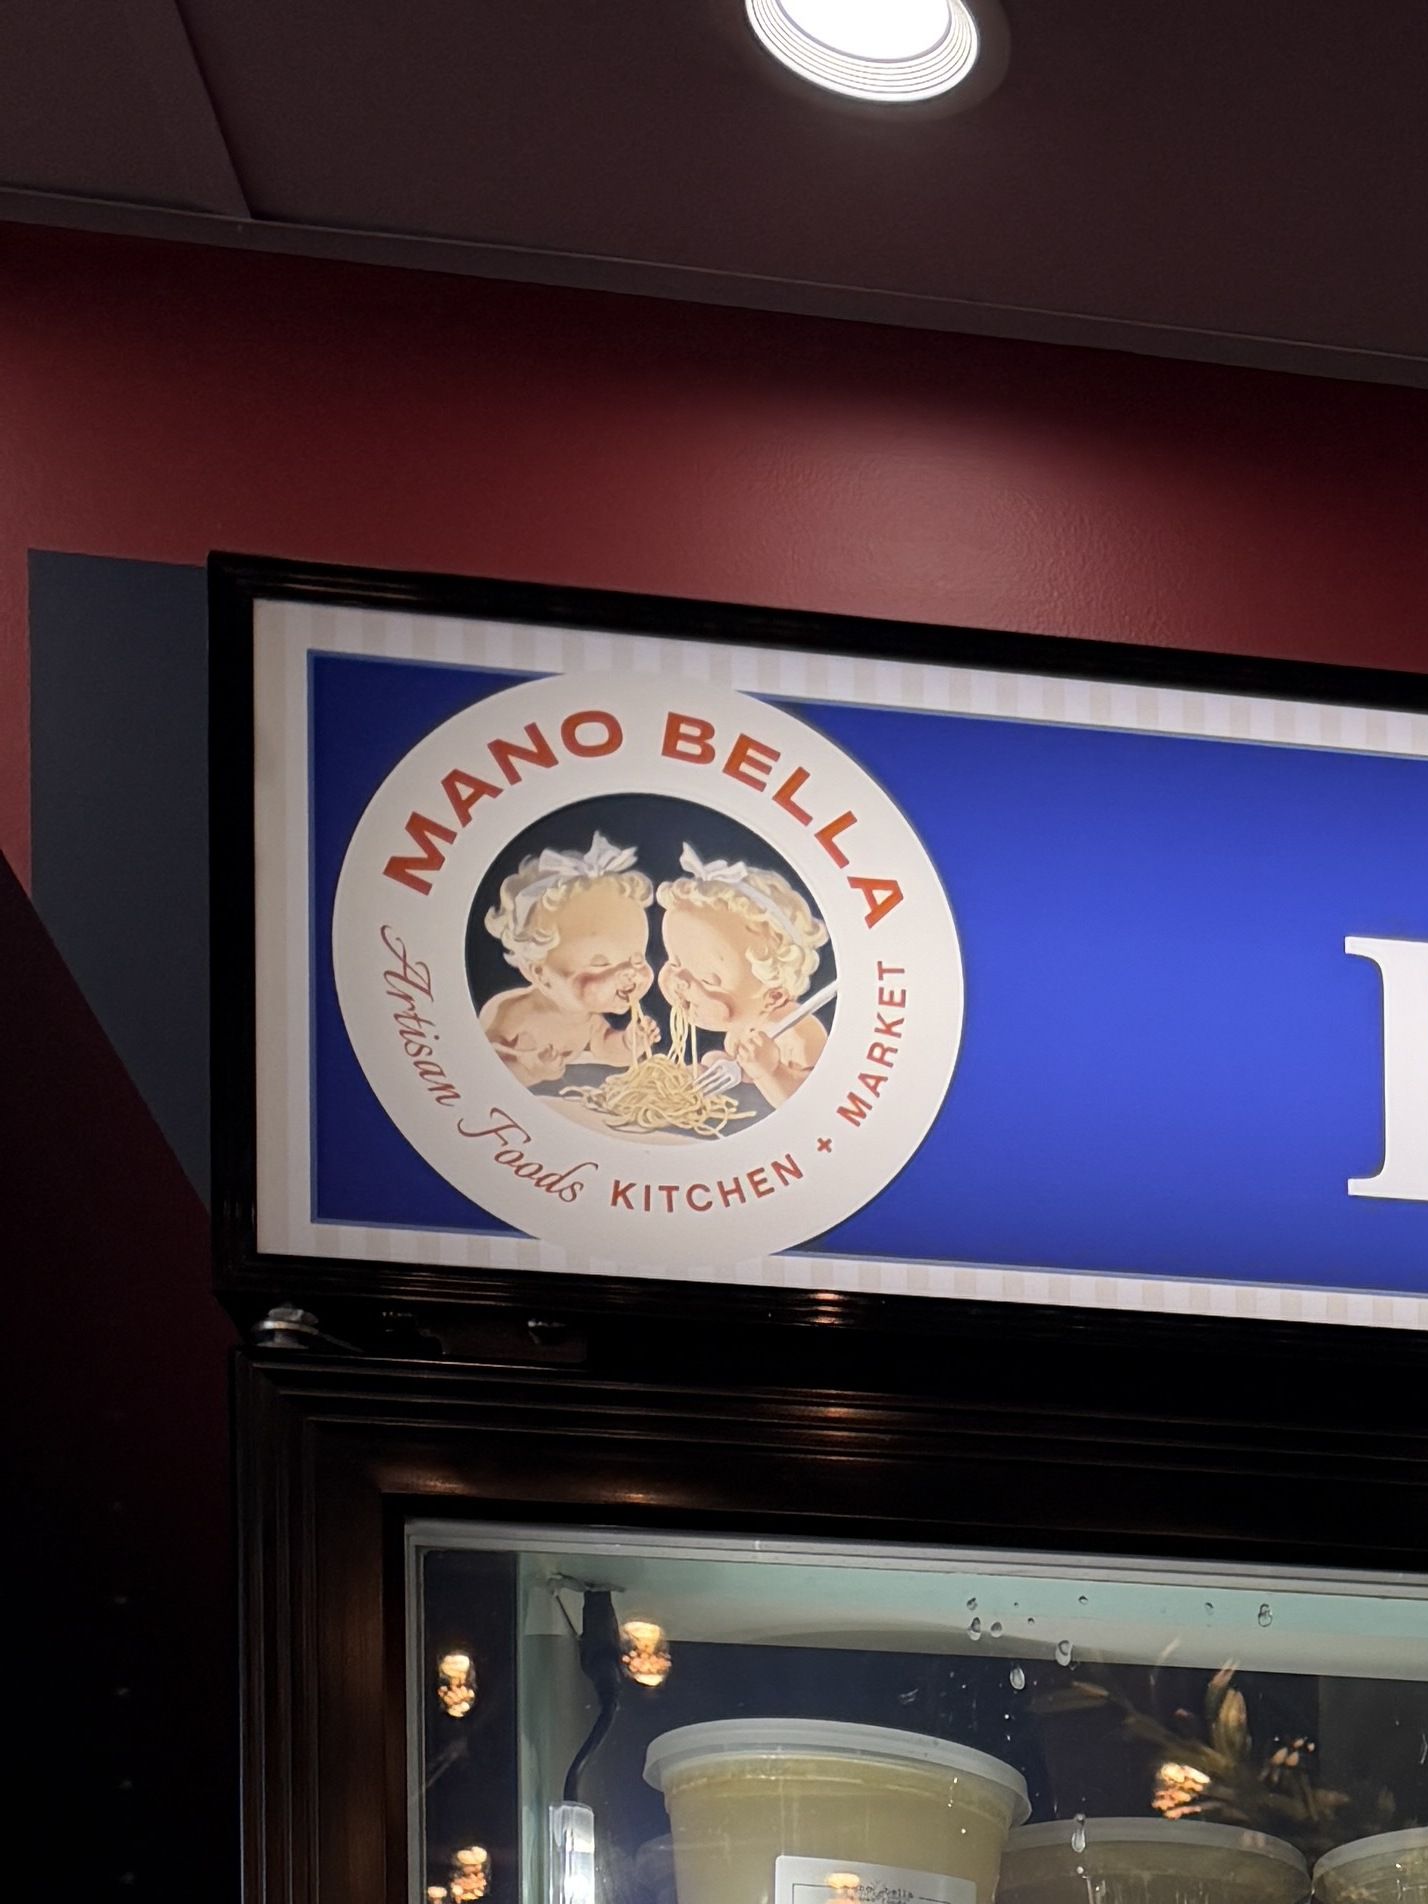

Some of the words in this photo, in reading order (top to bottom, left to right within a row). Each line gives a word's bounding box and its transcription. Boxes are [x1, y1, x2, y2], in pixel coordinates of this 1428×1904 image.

[383, 710, 624, 896] MANO
[661, 712, 904, 928] BELLA
[380, 925, 457, 1109] Artisan
[458, 1109, 598, 1204] Foods
[610, 1153, 805, 1214] KITCHEN
[836, 961, 907, 1128] MARKET
